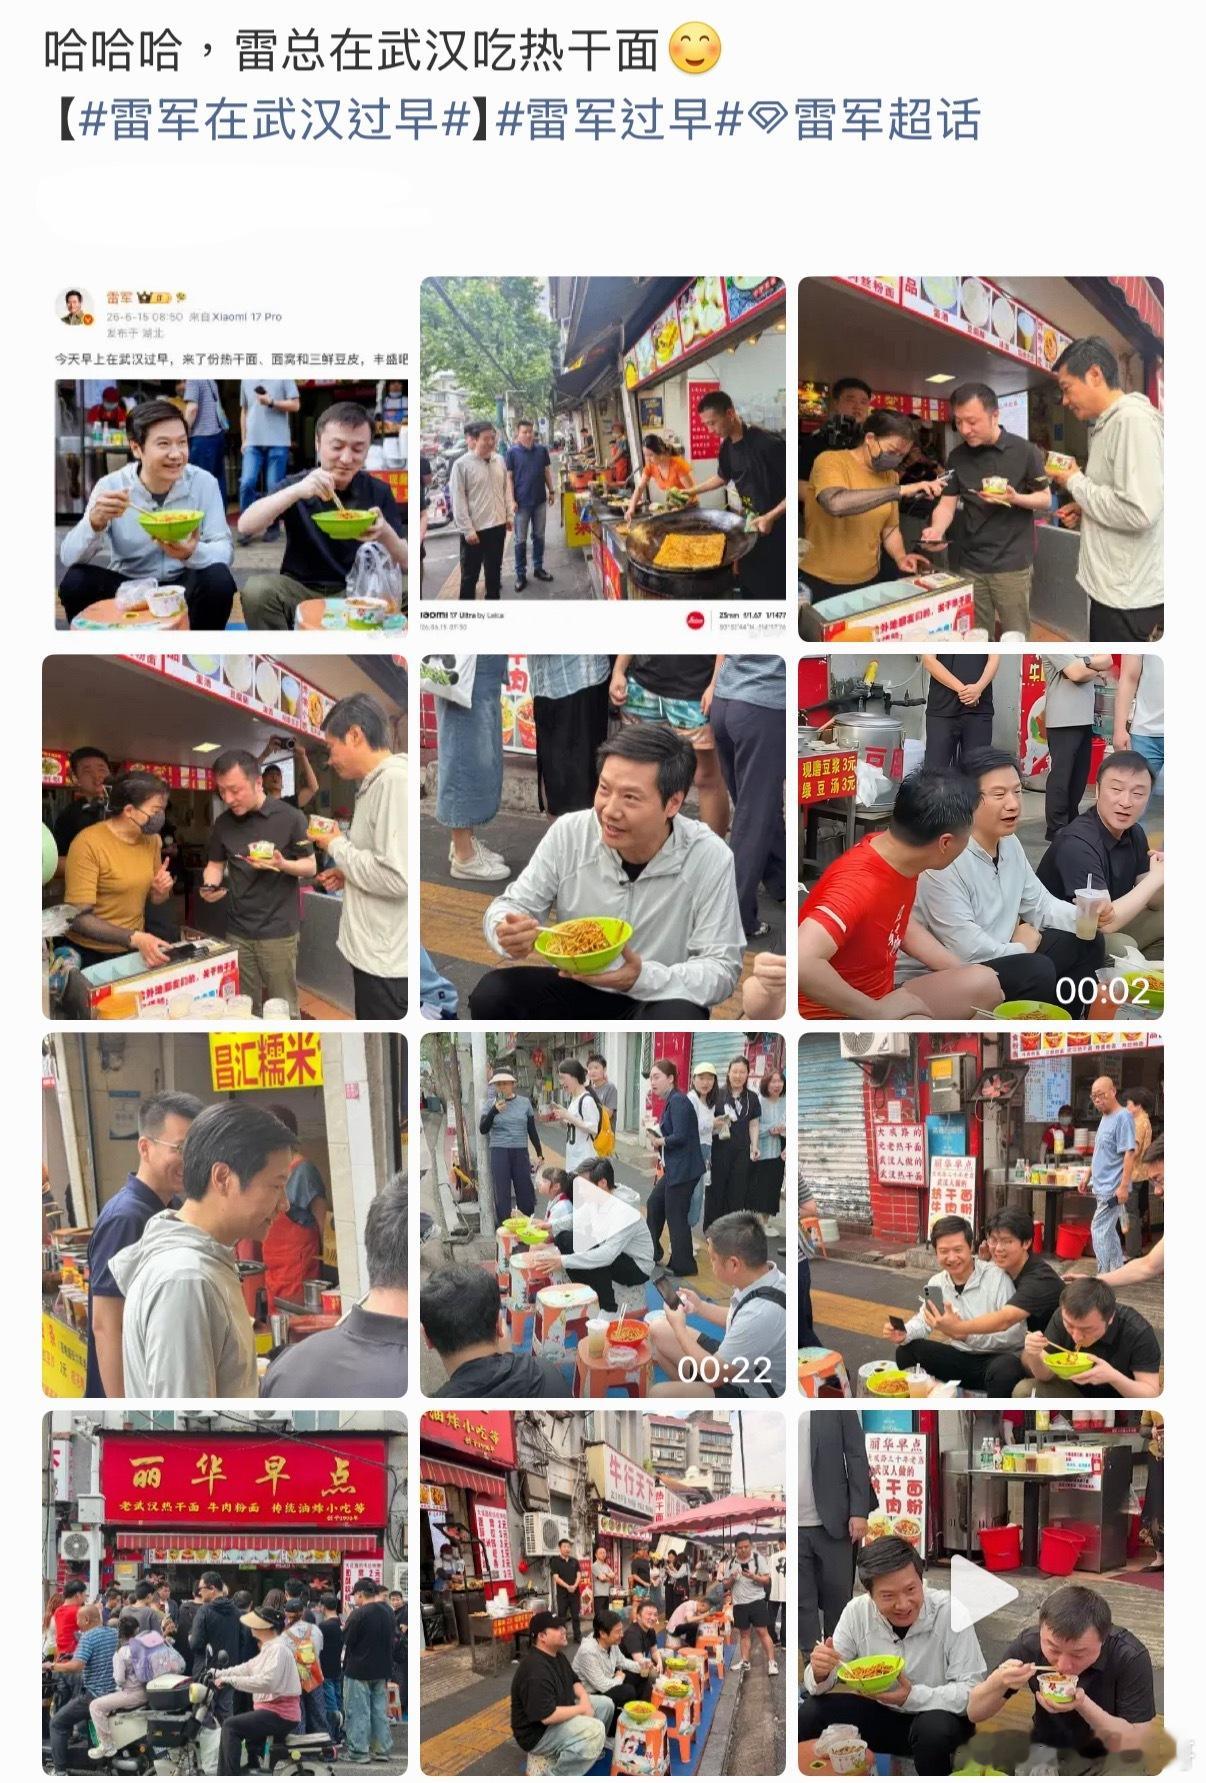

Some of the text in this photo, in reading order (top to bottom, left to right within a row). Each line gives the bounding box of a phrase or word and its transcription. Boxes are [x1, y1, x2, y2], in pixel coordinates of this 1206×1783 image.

[106, 291, 132, 305] 雷军
[152, 311, 184, 322] 08:50
[212, 311, 248, 322] Xiaomi
[251, 311, 261, 322] 17
[264, 311, 283, 322] Pro
[802, 757, 840, 778] 现磨豆浆
[802, 778, 840, 799] 绿豆汤
[214, 1032, 321, 1089] 昌汇糯米
[869, 1437, 922, 1452] 丽华早点
[129, 1453, 357, 1497] 丽华早点
[119, 1501, 366, 1514] 老武汉热干面 牛肉粉面 传统油炸小吃等
